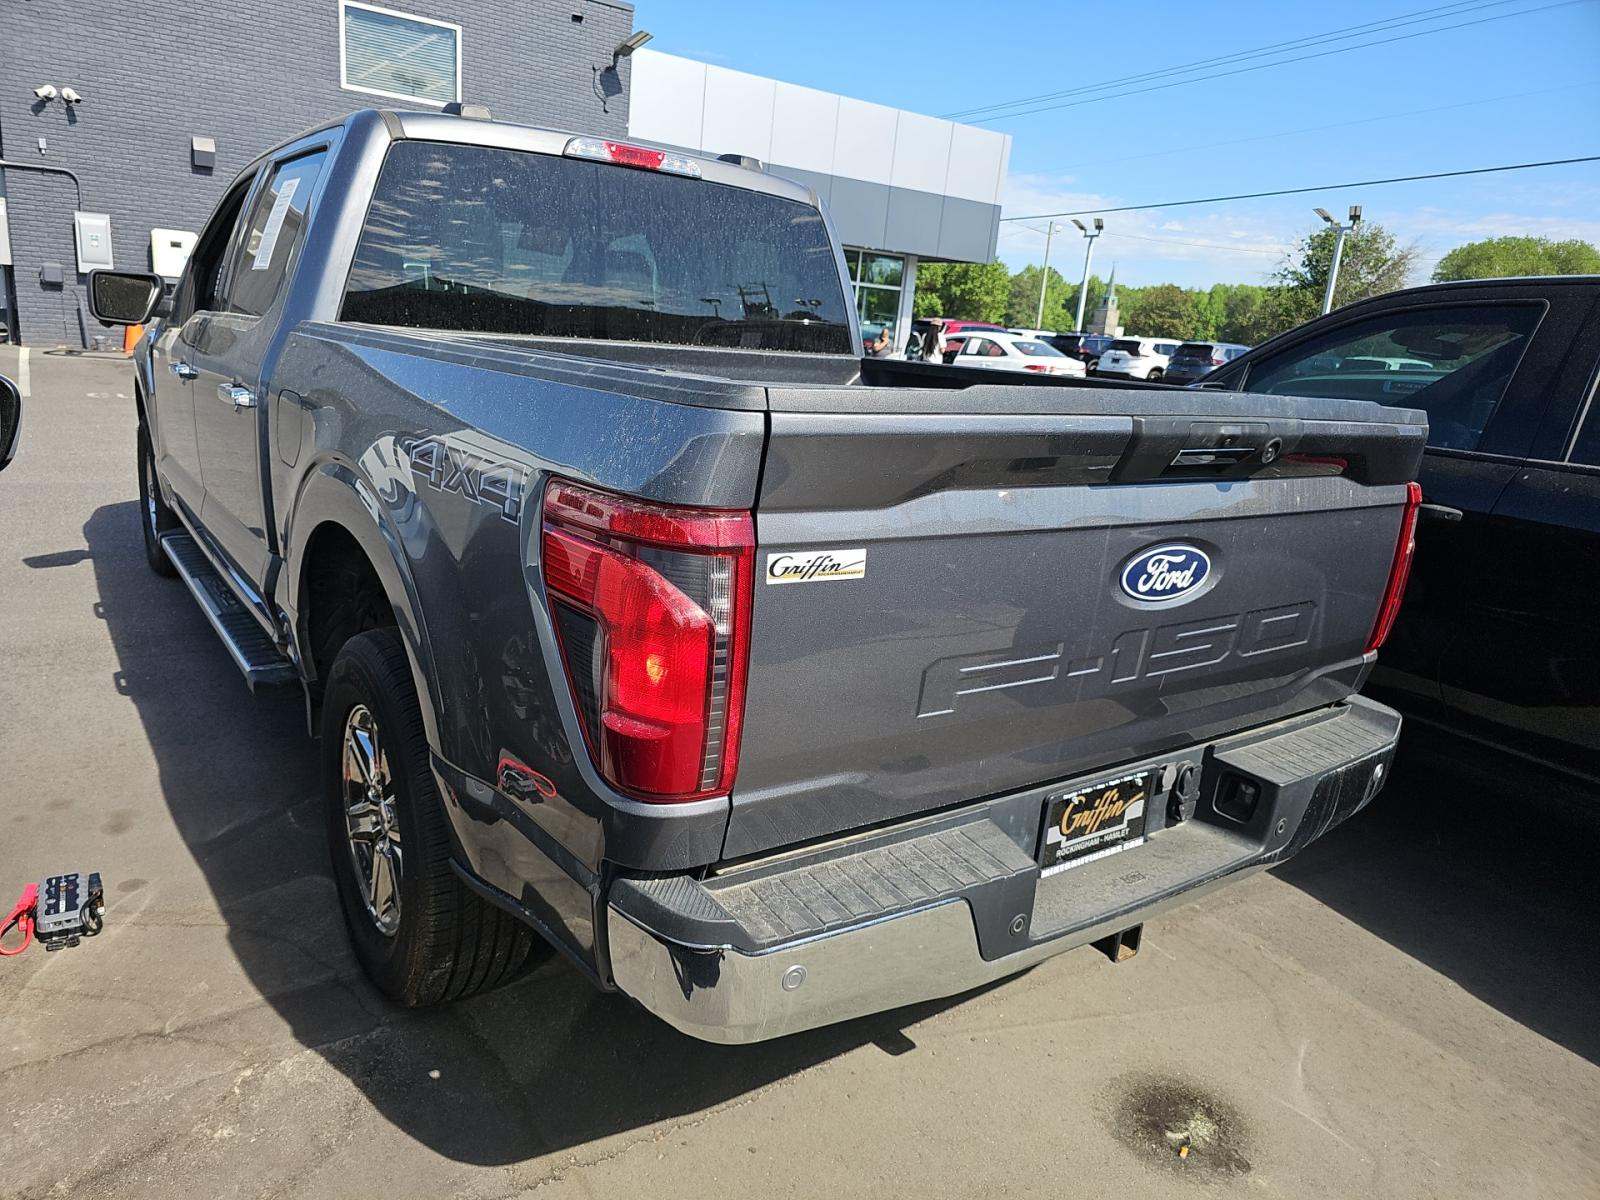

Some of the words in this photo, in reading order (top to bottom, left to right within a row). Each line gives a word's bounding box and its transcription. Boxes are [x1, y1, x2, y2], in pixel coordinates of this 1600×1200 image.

[769, 555, 864, 580] Griffin
[1137, 553, 1196, 592] Ford
[916, 600, 1318, 718] F-150
[1060, 788, 1144, 835] Griffin
[1055, 837, 1100, 858] ROCKINGHAM
[1104, 827, 1131, 843] HAMLET
